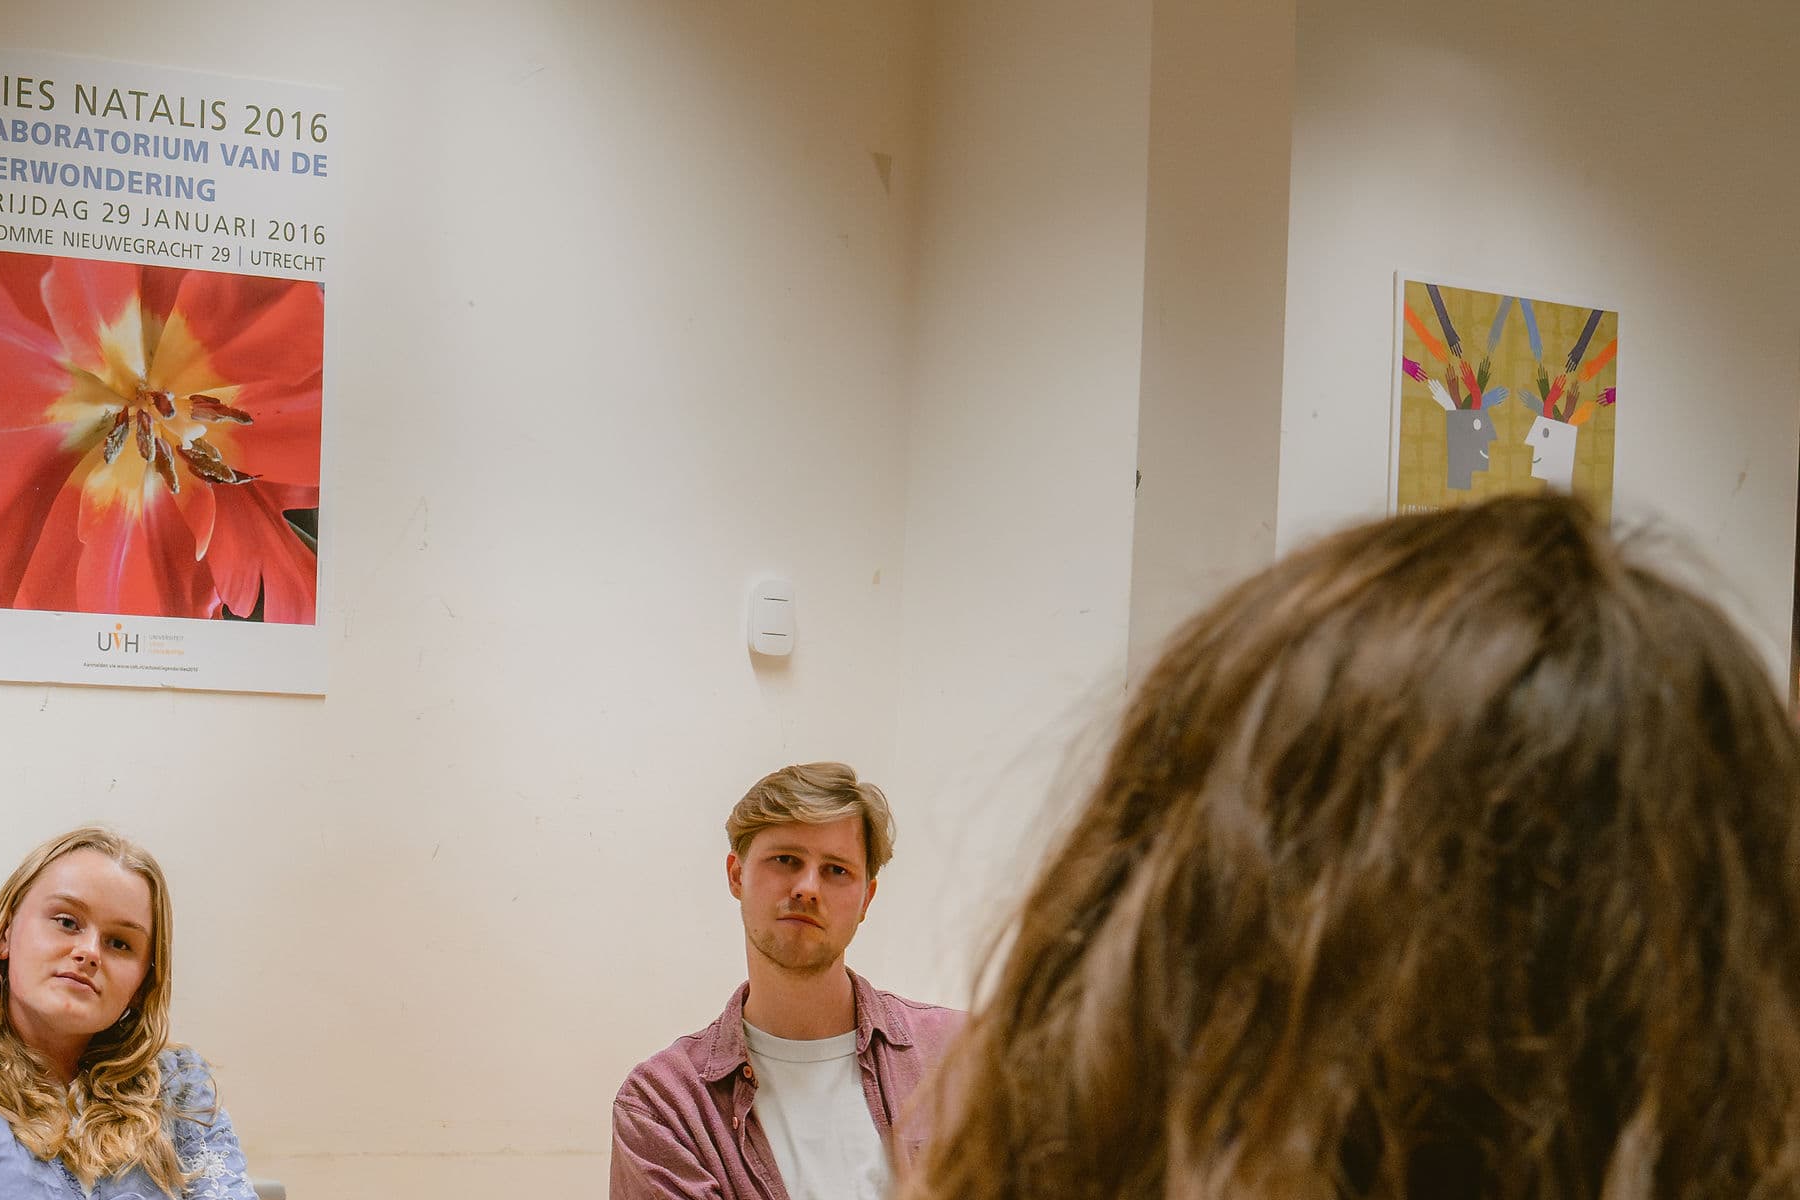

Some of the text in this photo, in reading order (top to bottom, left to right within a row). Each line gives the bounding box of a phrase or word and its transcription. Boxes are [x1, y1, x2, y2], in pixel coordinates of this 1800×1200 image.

[74, 83, 227, 131] NATALIS
[244, 104, 328, 143] 2016
[221, 143, 280, 173] VAN
[292, 151, 328, 178] DE
[102, 202, 131, 225] 29
[142, 207, 255, 238] JANUARI
[268, 220, 325, 246] 2016
[63, 230, 203, 260] NIEUWEGRACHT
[211, 246, 231, 263] 29
[251, 250, 325, 273] UTRECHT
